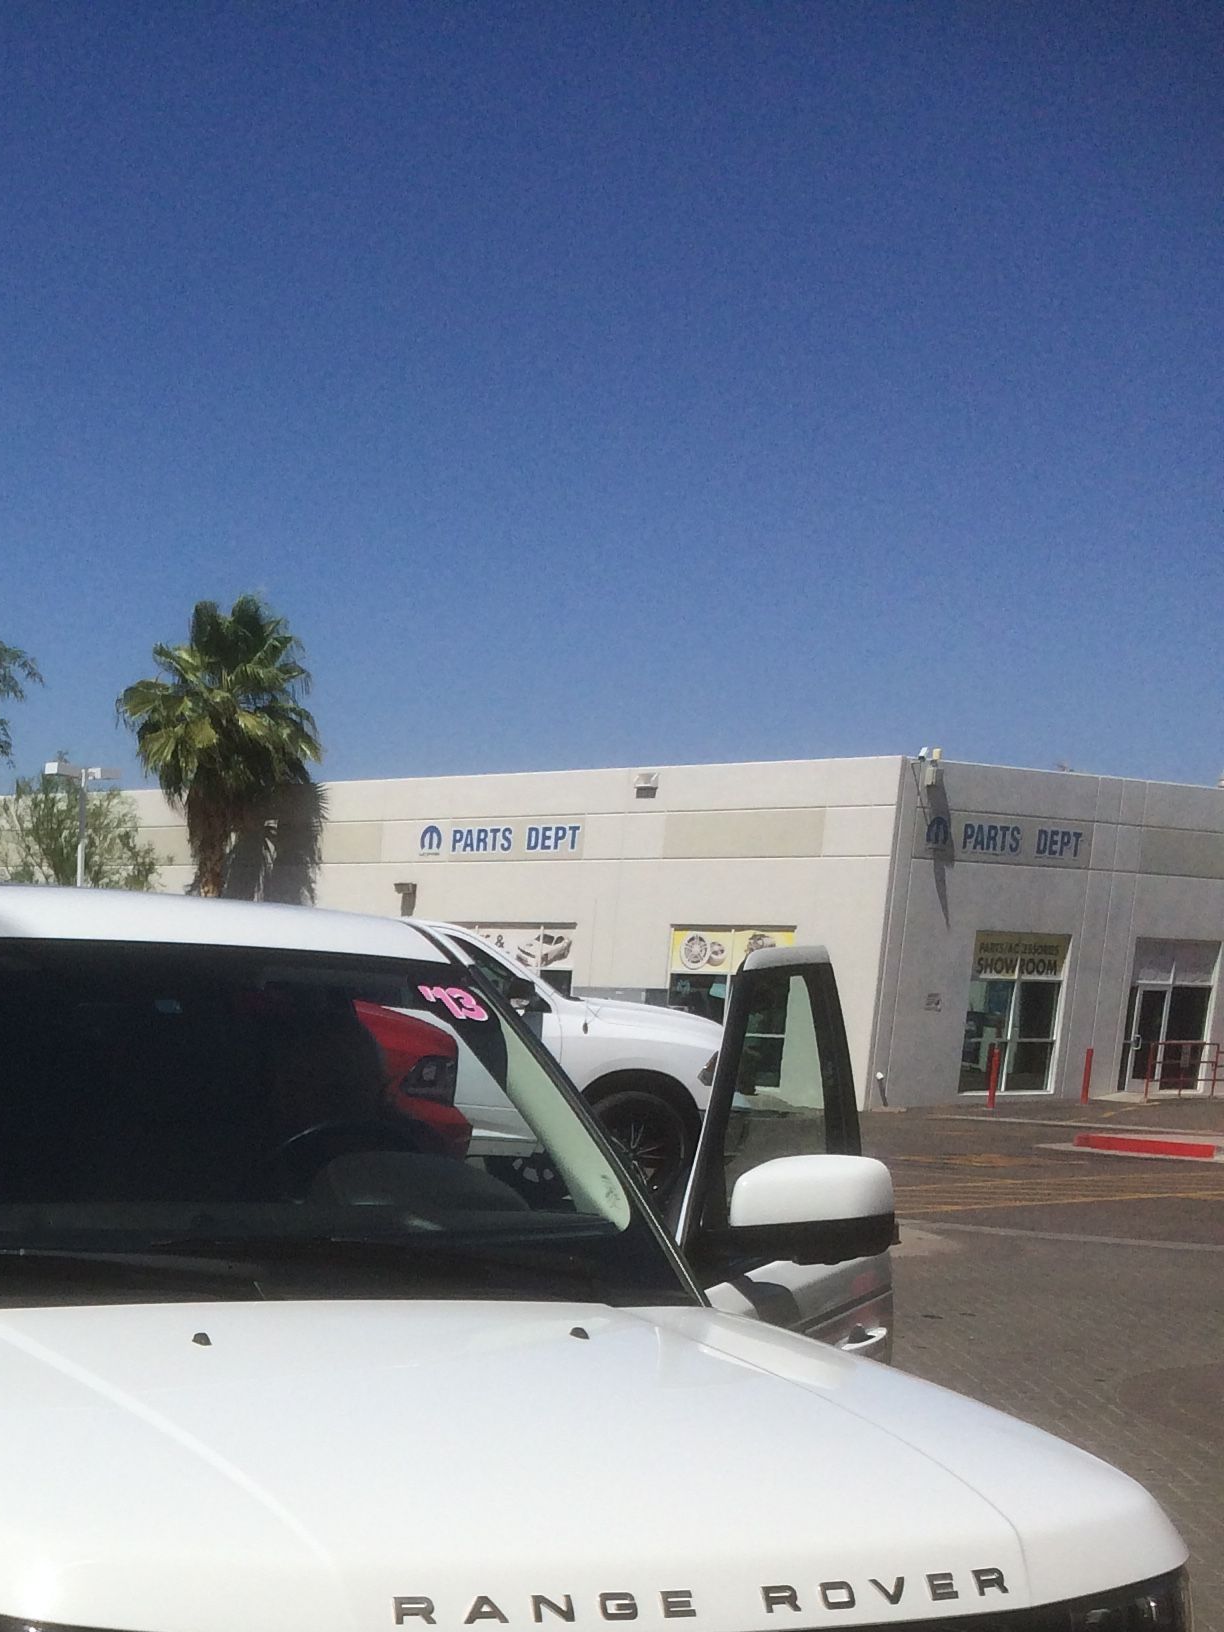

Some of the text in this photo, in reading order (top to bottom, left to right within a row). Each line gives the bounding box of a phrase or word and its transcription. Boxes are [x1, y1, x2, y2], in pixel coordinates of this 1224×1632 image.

[451, 825, 581, 852] PARTS DEPT
[962, 823, 1083, 857] PARTS DEPT
[976, 957, 1057, 976] SHOWROOM
[392, 1566, 1010, 1625] RANGE ROVER
